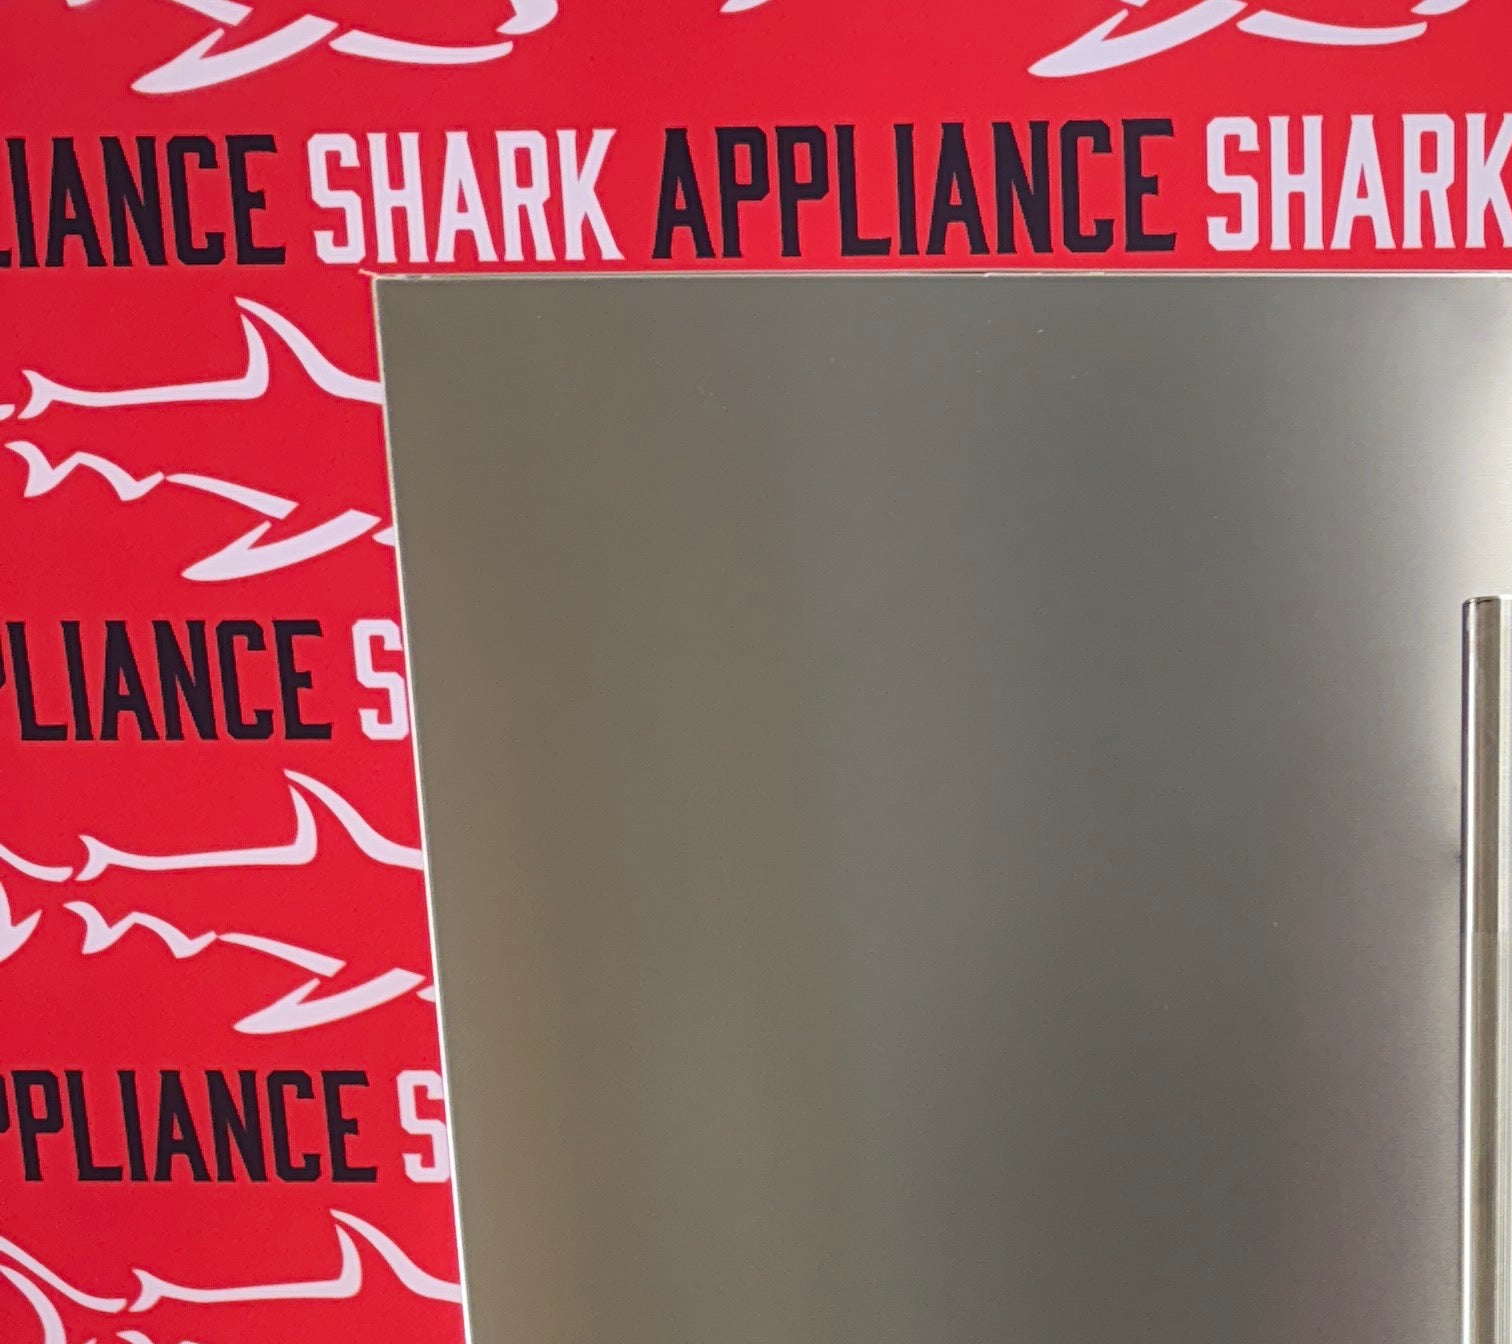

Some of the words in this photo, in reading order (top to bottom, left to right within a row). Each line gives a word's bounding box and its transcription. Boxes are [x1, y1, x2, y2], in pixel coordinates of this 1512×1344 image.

[0, 135, 286, 267] IANCE
[306, 129, 625, 264] SHARK
[650, 118, 1177, 259] APPLIANCE
[0, 619, 333, 741] LIANCE
[0, 1069, 378, 1183] PLIANCE
